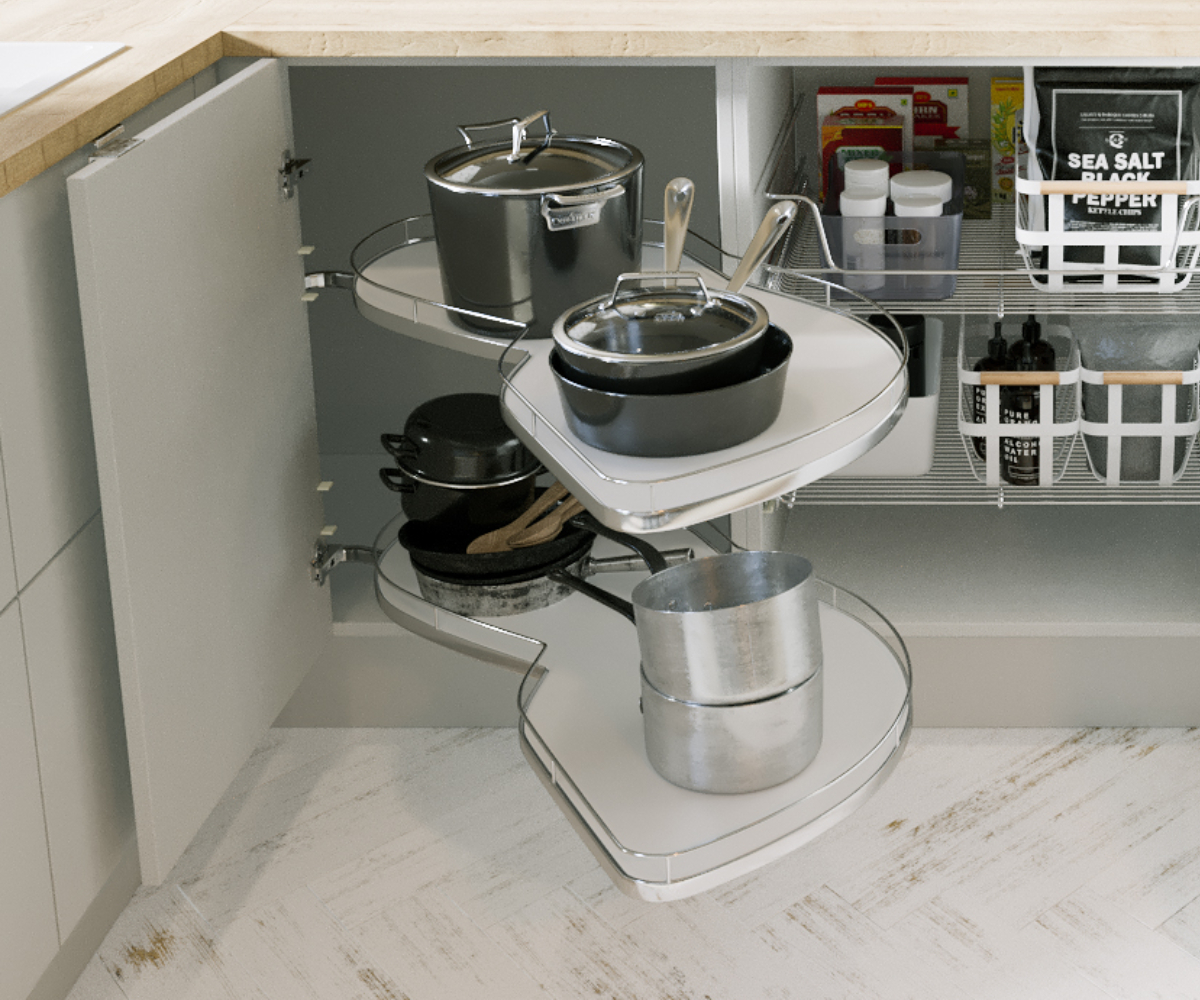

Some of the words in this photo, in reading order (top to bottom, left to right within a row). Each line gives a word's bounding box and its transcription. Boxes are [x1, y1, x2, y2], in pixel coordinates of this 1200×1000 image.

[1067, 152, 1109, 170] SEA
[1113, 152, 1165, 170] SALT
[1072, 193, 1157, 208] PEPPER
[1118, 208, 1142, 216] CHIPS
[1004, 408, 1030, 419] PURE
[1004, 446, 1037, 456] WATER
[1004, 454, 1018, 463] OIL
